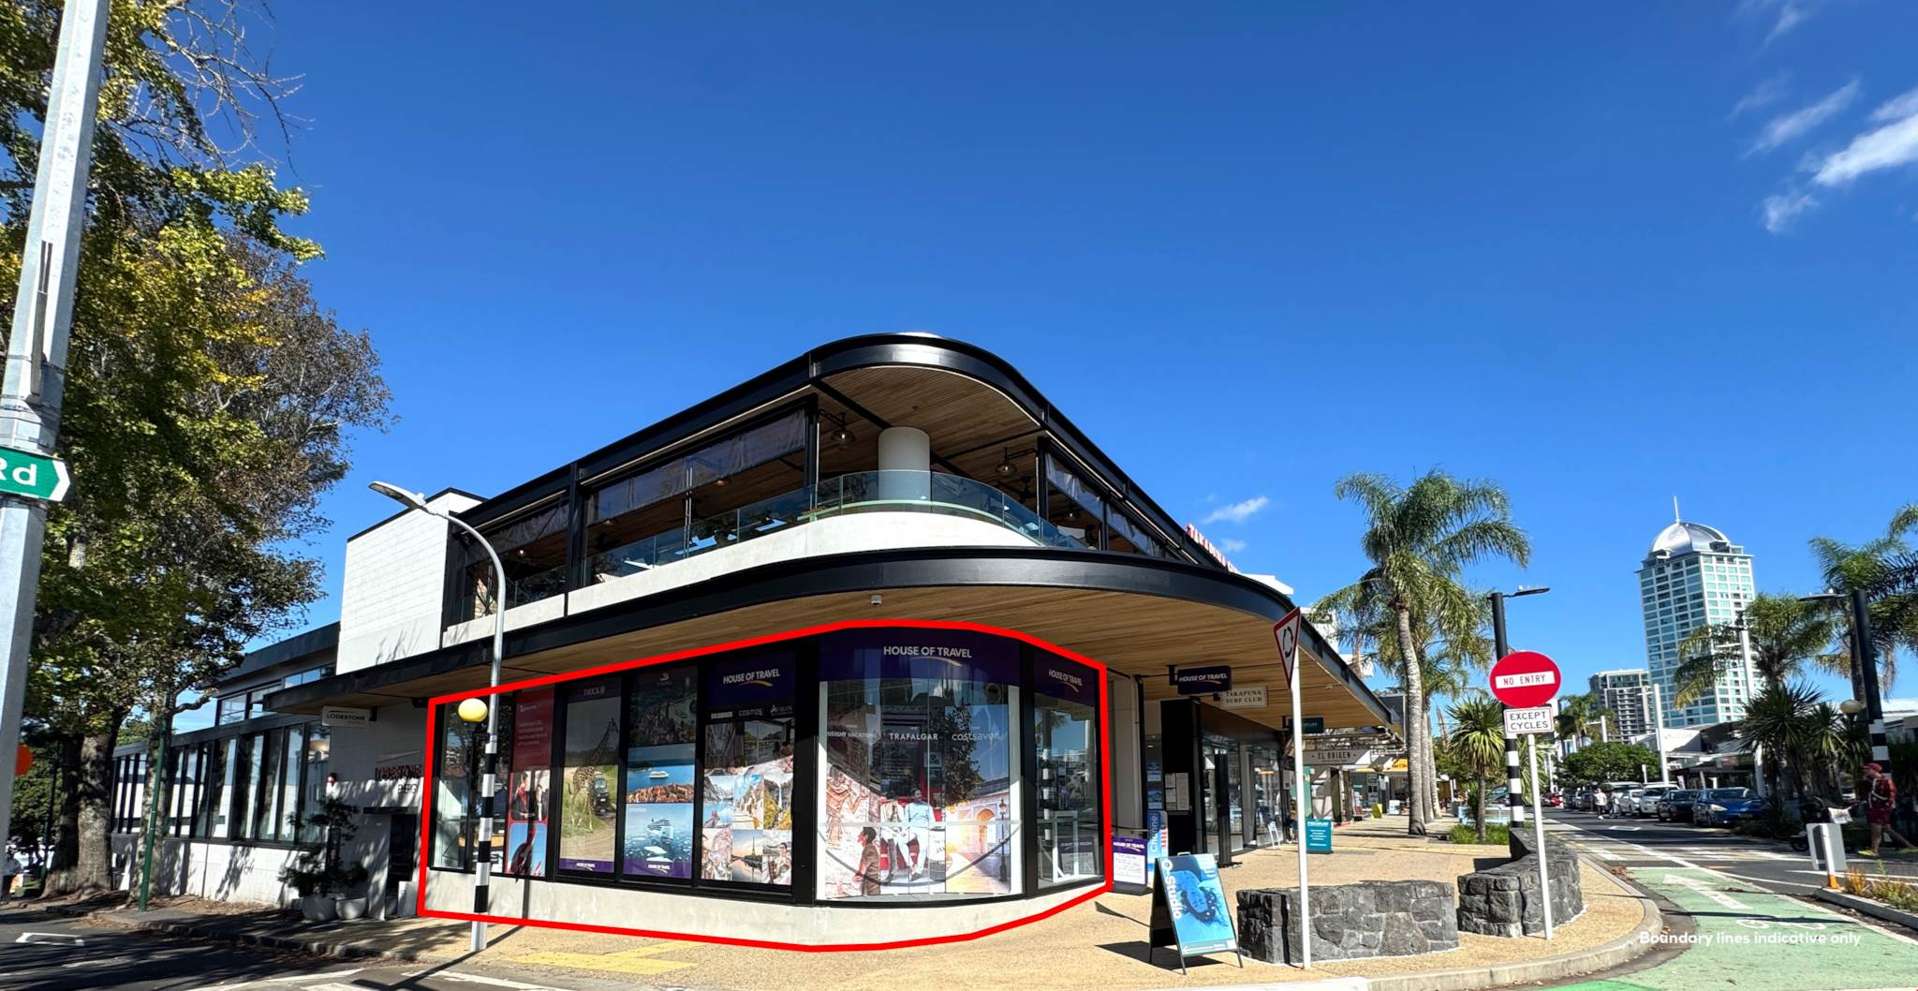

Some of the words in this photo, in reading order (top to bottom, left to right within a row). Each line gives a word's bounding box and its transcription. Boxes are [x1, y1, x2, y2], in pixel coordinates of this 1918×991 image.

[883, 646, 919, 656] HOUSE
[920, 646, 936, 656] OF
[937, 647, 972, 658] TRAVEL
[723, 673, 745, 684] HOUSE
[745, 672, 755, 681] OF
[755, 668, 780, 679] TRAVEL
[1503, 677, 1514, 686] NO
[1520, 674, 1546, 684] ENTRY
[1510, 711, 1547, 721] EXCEPT
[1510, 721, 1549, 730] CYCLES
[889, 732, 938, 741] TRAFALGAR
